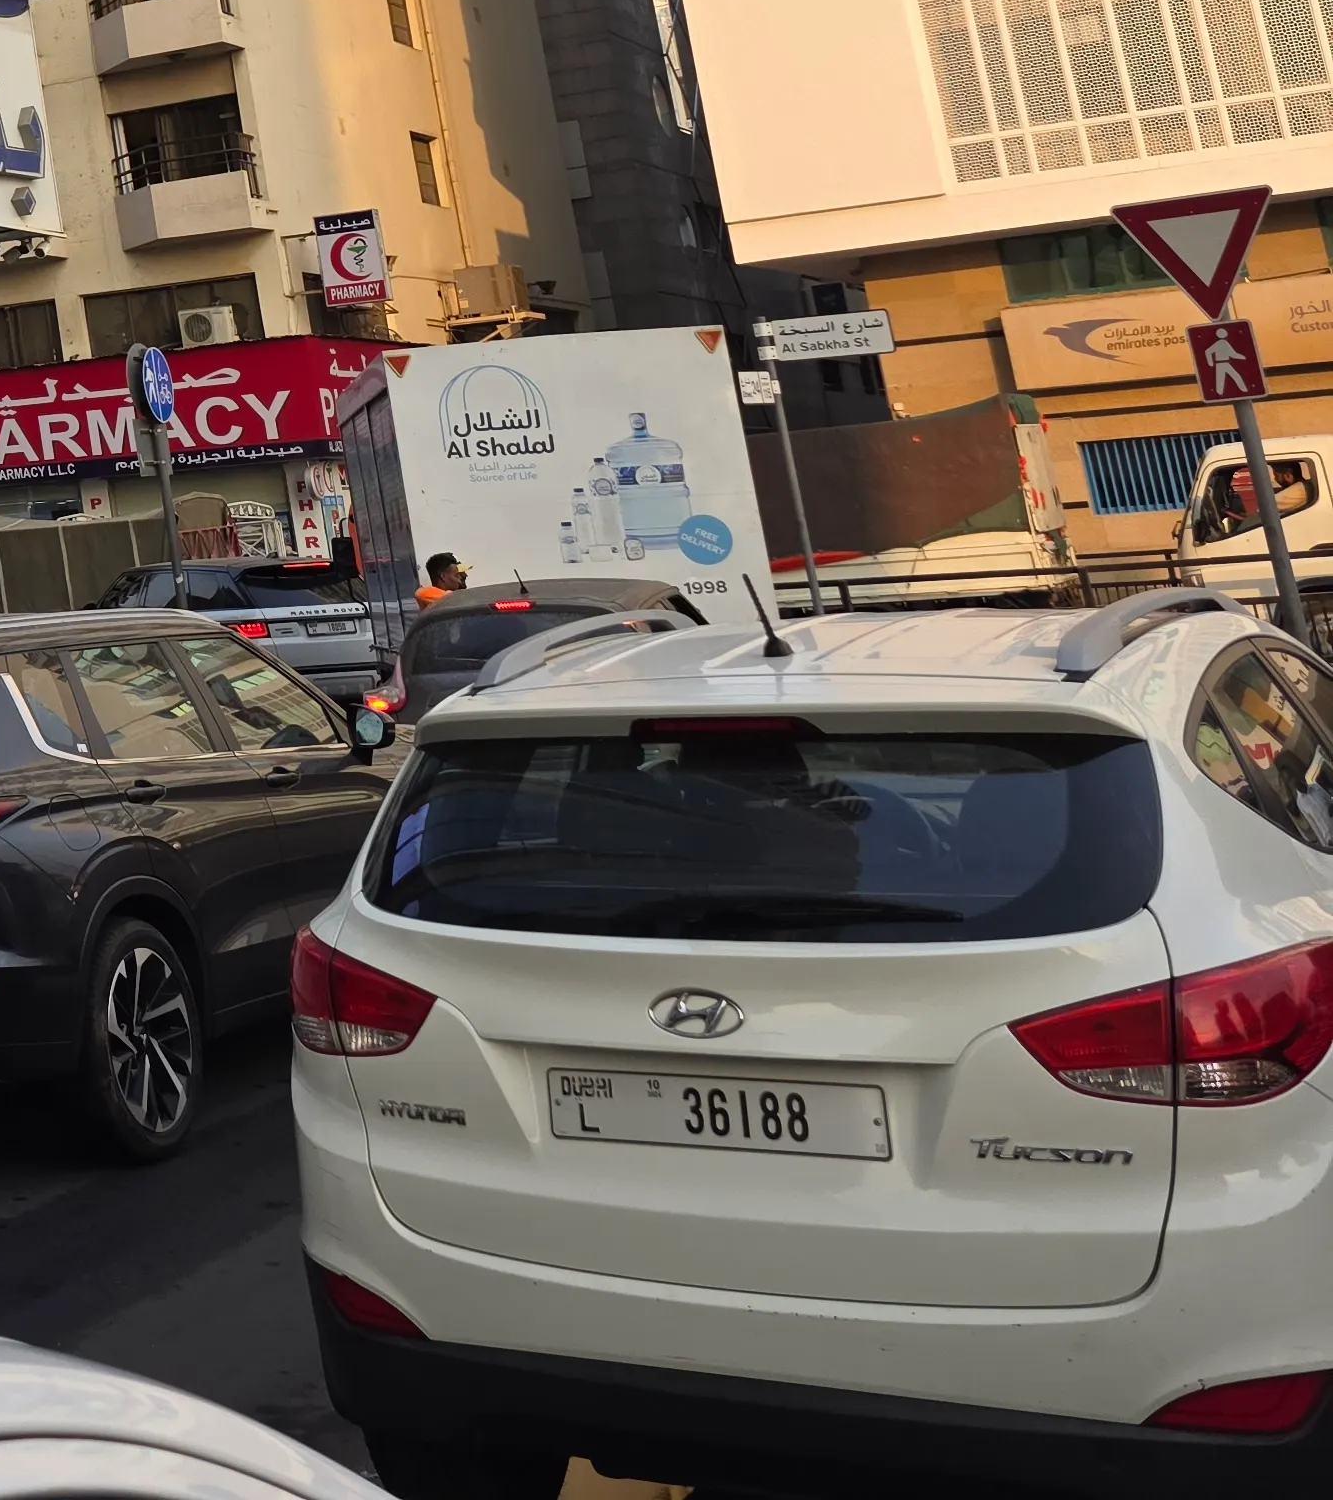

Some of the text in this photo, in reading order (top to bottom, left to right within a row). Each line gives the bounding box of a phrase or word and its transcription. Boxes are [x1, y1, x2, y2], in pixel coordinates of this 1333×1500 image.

[318, 218, 372, 232] صيدلية
[330, 282, 381, 301] PHARMACY
[778, 317, 884, 338] شارع السبخة
[1153, 324, 1175, 337] بريد
[782, 336, 871, 354] Al Sabkha St
[1106, 334, 1189, 352] emirates pos
[453, 408, 541, 438] الشلال
[236, 444, 305, 460] صيدلية
[447, 433, 555, 459] Al Shalal
[177, 448, 235, 466] الجزيرة
[47, 462, 77, 477] L.L.C
[468, 461, 537, 474] مصدر الحياة
[469, 470, 538, 483] Source of Life
[680, 532, 726, 555] DELIVERY
[694, 527, 720, 543] FREE
[683, 580, 728, 596] 1998
[578, 1086, 811, 1143] L 36188
